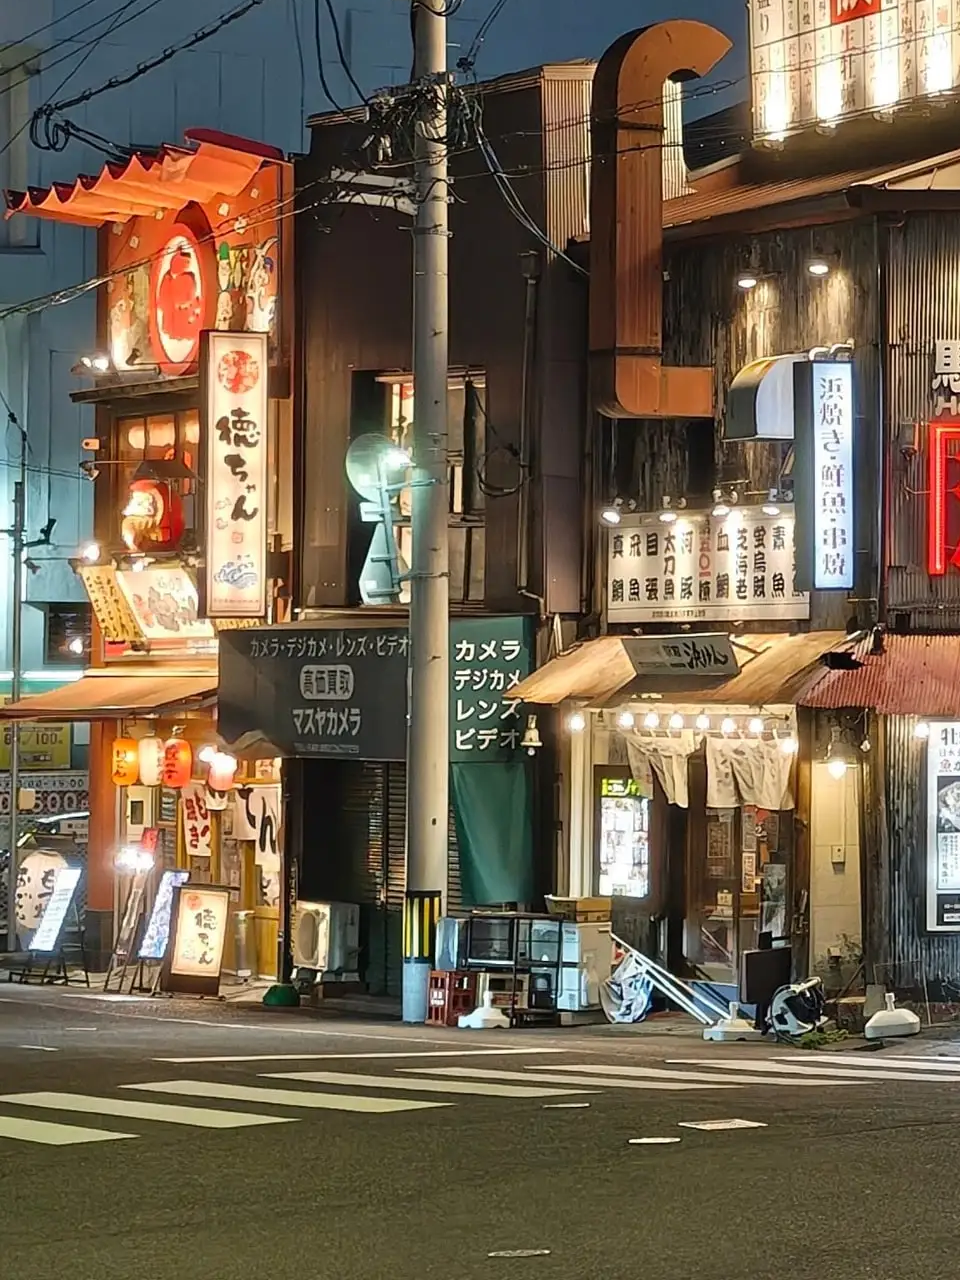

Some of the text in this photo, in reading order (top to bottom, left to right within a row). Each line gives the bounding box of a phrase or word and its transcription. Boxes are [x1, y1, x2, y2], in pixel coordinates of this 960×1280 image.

[215, 407, 261, 522] 徳ちゃん
[628, 533, 641, 601] 飛魚
[663, 531, 676, 601] 太刀魚
[455, 640, 521, 661] カメラ
[302, 669, 352, 696] 高価買取
[454, 669, 520, 691] デジカメ
[293, 707, 361, 736] マスヤカメラ
[456, 699, 520, 721] レンズ
[456, 728, 520, 750] ビデオ
